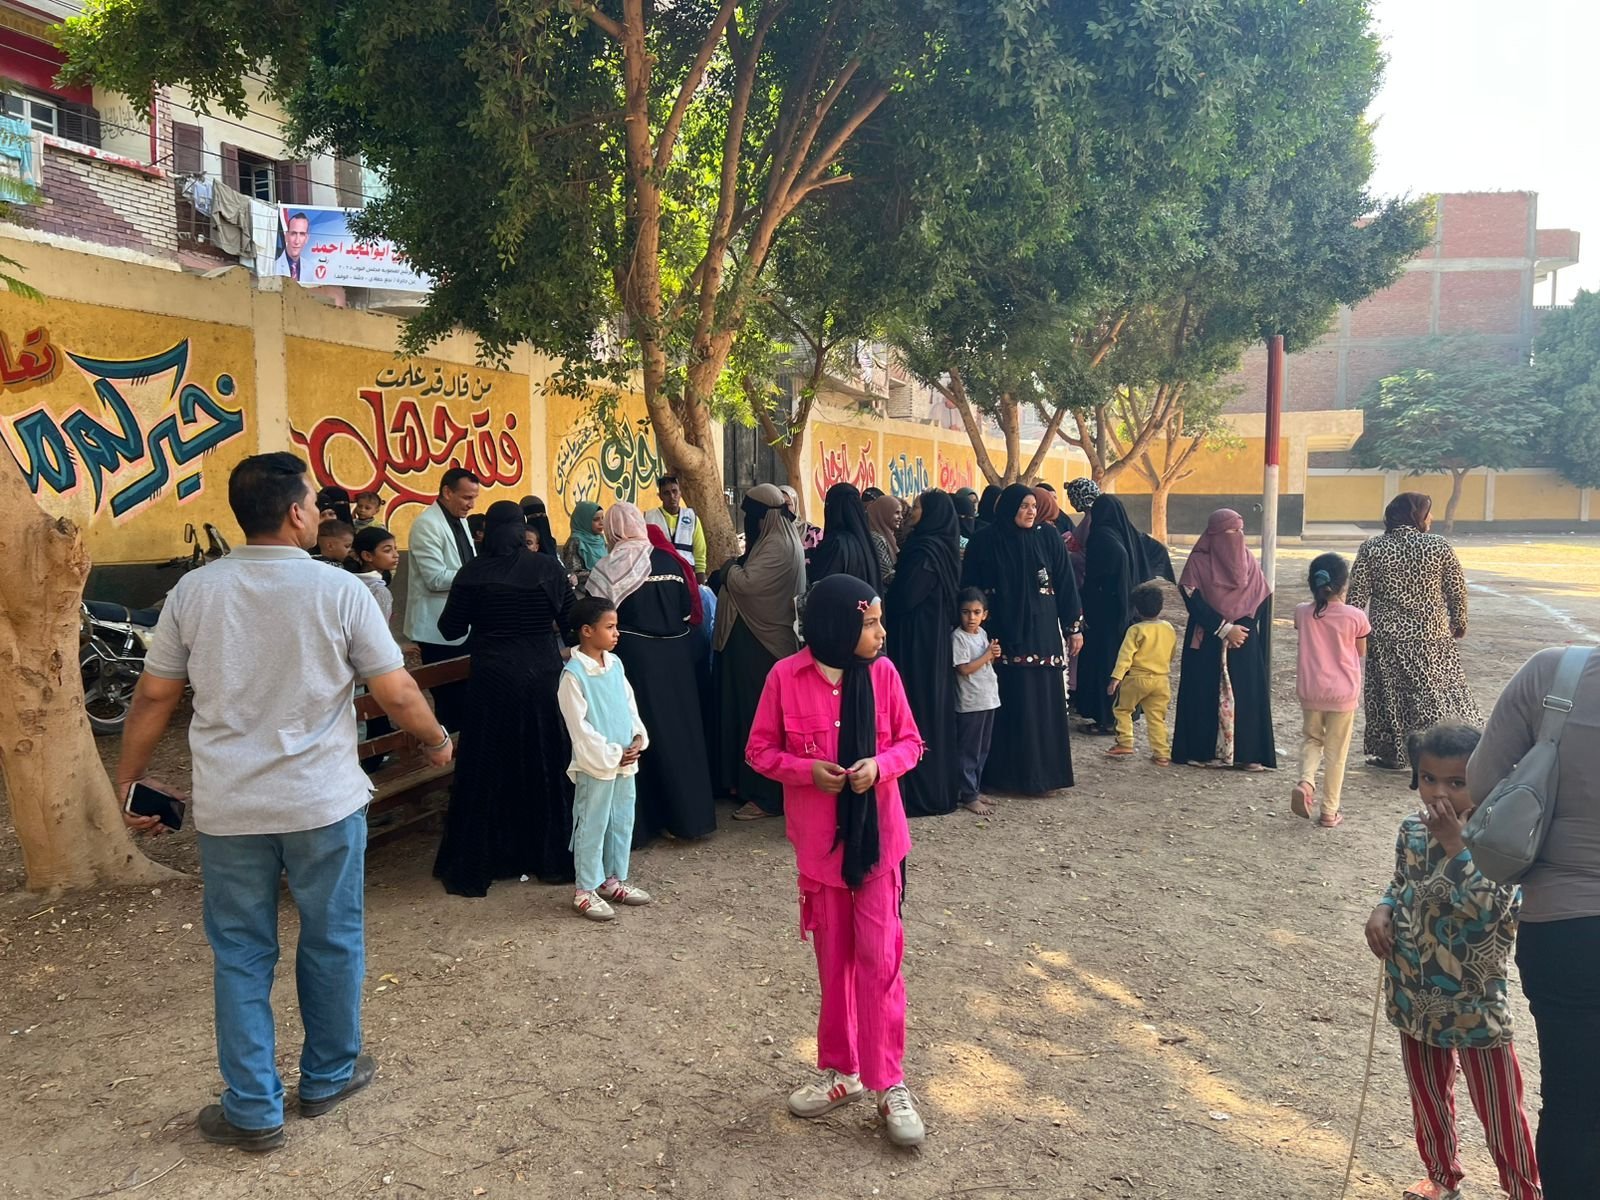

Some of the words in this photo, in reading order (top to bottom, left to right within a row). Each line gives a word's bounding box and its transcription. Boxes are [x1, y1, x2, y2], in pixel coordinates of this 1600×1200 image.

[312, 242, 343, 253] احمد
[376, 363, 427, 388] علمت
[420, 367, 445, 396] قد
[444, 373, 469, 397] قال
[472, 378, 492, 400] من
